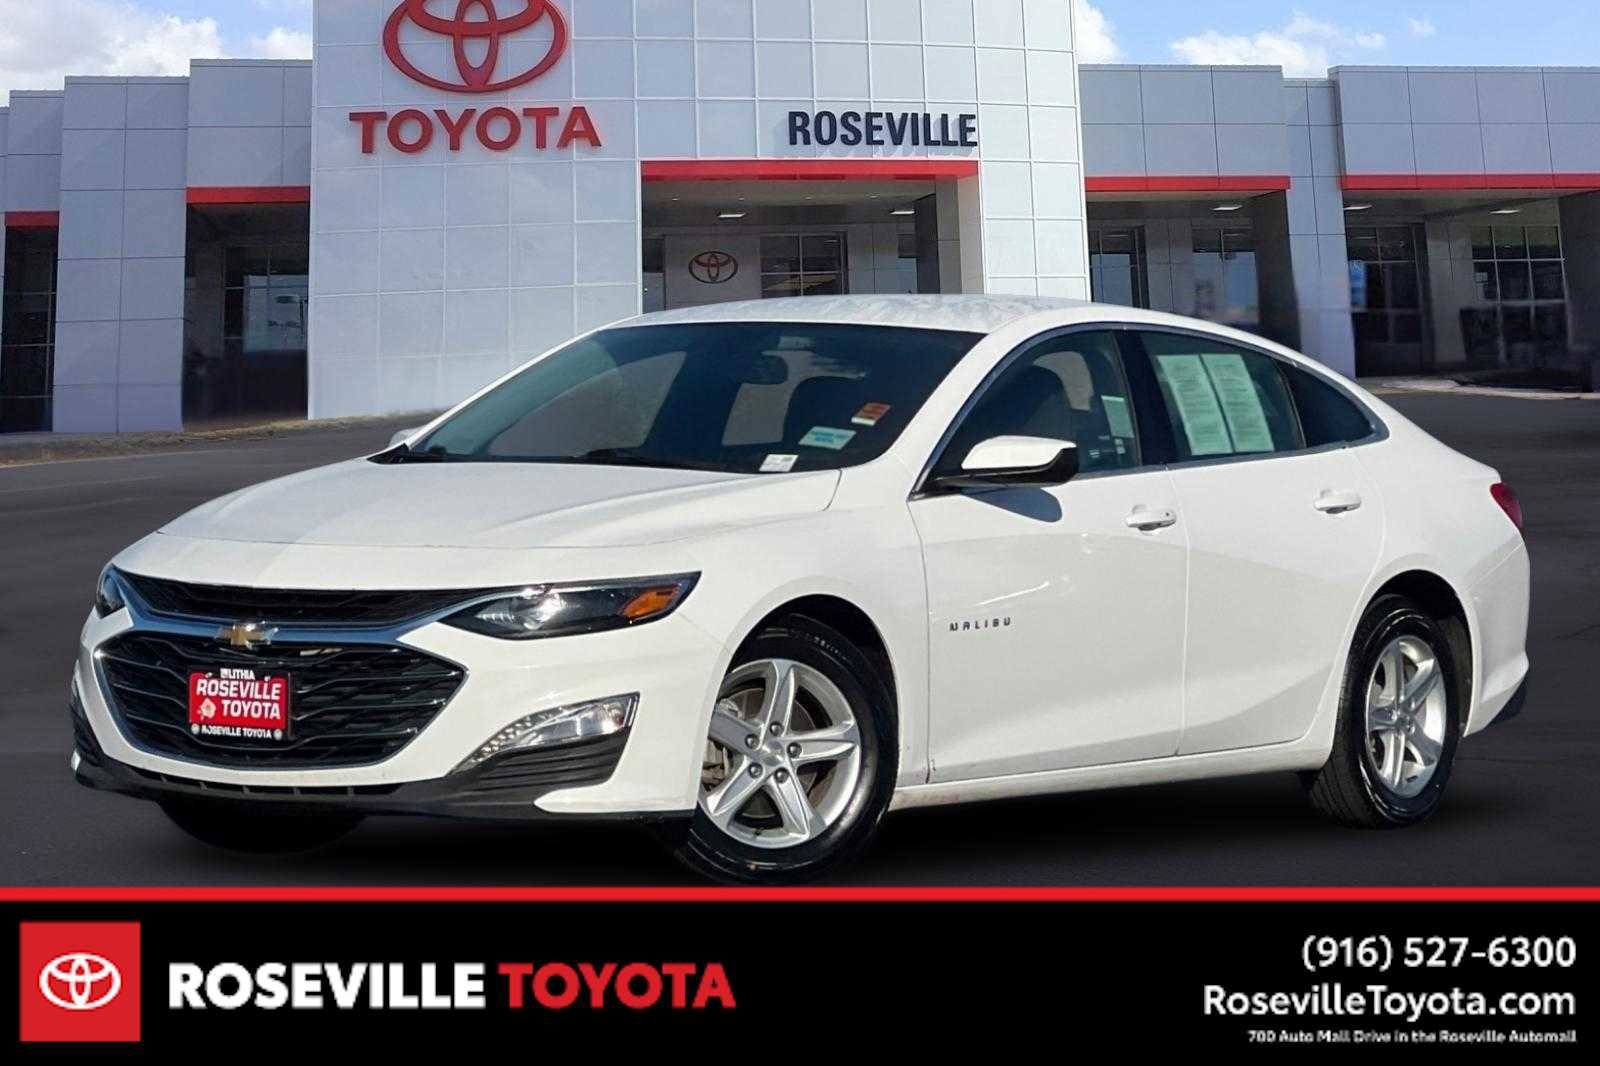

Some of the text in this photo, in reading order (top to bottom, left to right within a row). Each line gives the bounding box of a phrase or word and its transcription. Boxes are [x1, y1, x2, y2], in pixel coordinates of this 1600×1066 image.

[349, 106, 602, 154] TOYOTA
[788, 111, 978, 147] ROSEVILLE
[949, 617, 1011, 632] MALIBU
[196, 679, 281, 700] ROSEVILLE
[221, 700, 280, 720] TOYOTA
[201, 725, 272, 739] ROSEVILLE TOYOTA
